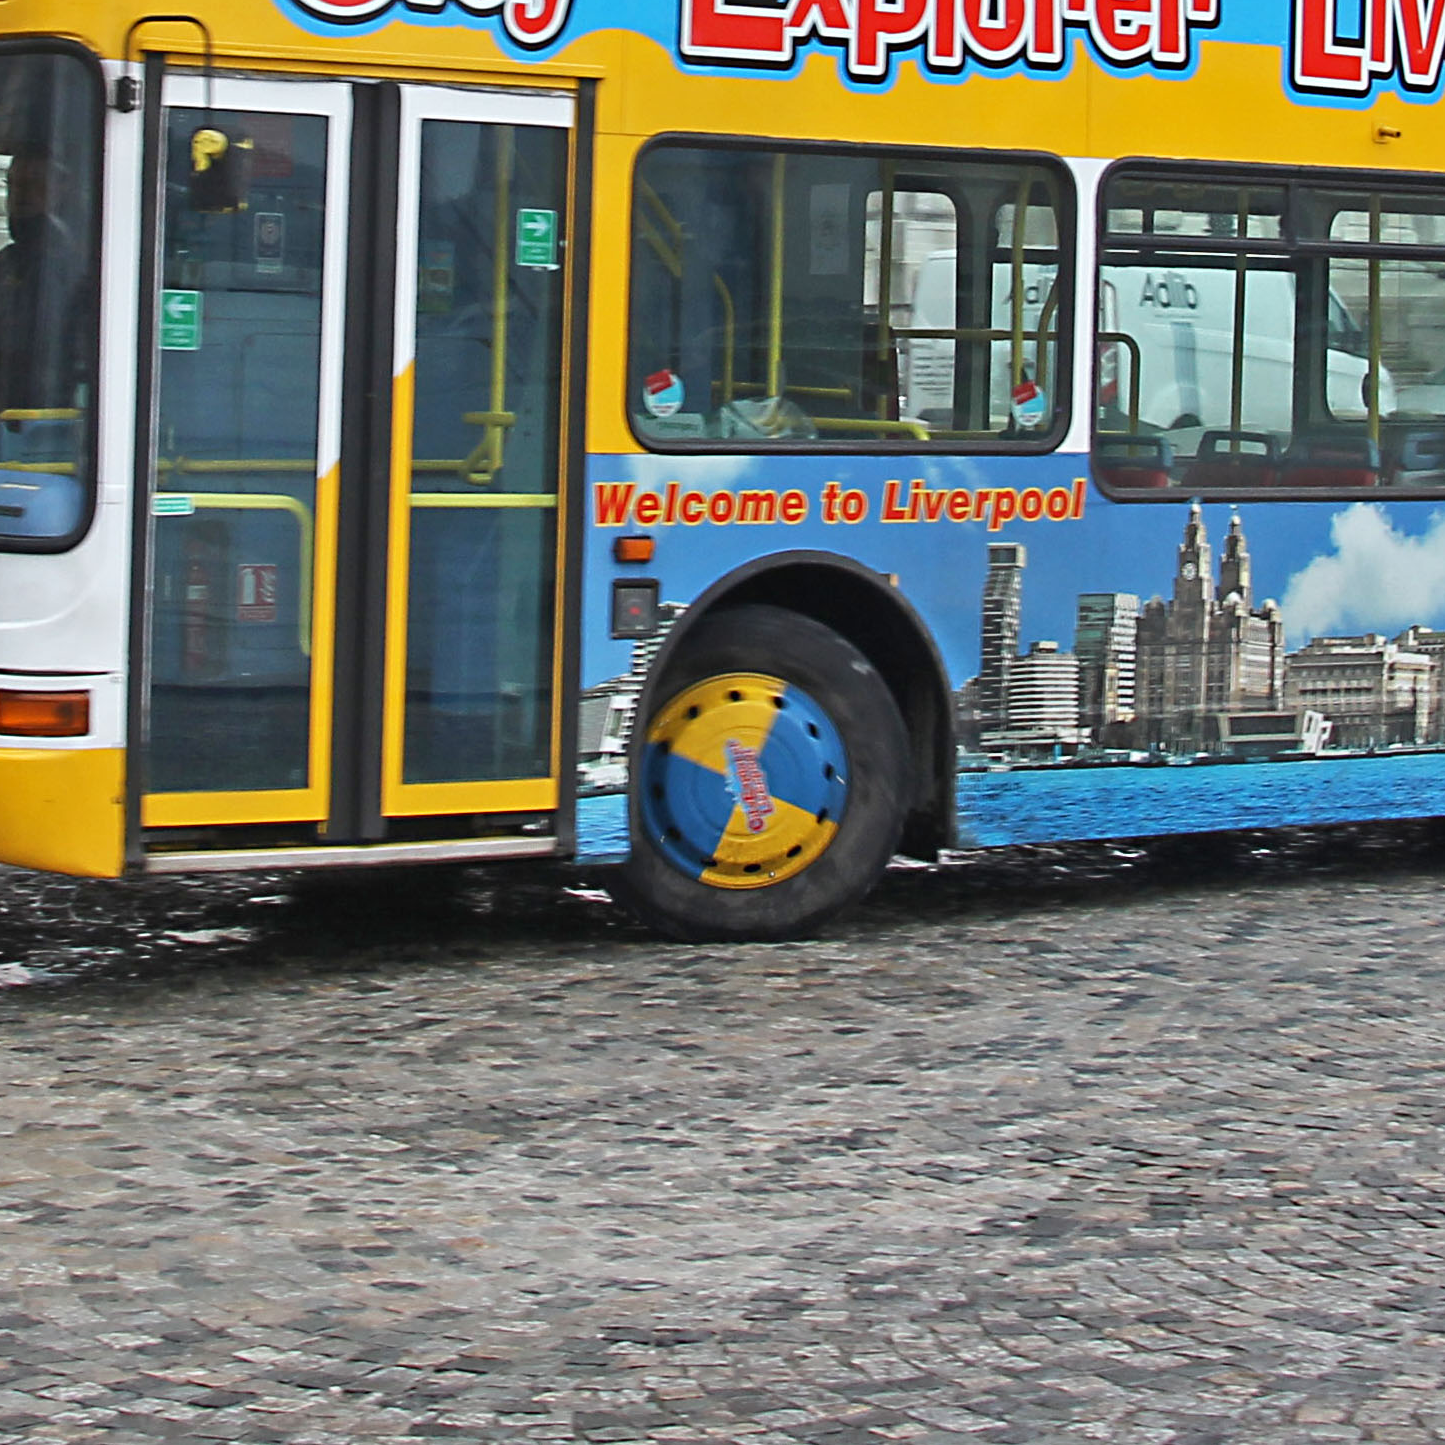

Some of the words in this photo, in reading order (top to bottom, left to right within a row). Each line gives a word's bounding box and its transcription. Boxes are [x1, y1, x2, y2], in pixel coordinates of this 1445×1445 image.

[593, 481, 807, 527] Welcome
[821, 481, 867, 523] to
[881, 478, 1087, 531] Liverpool
